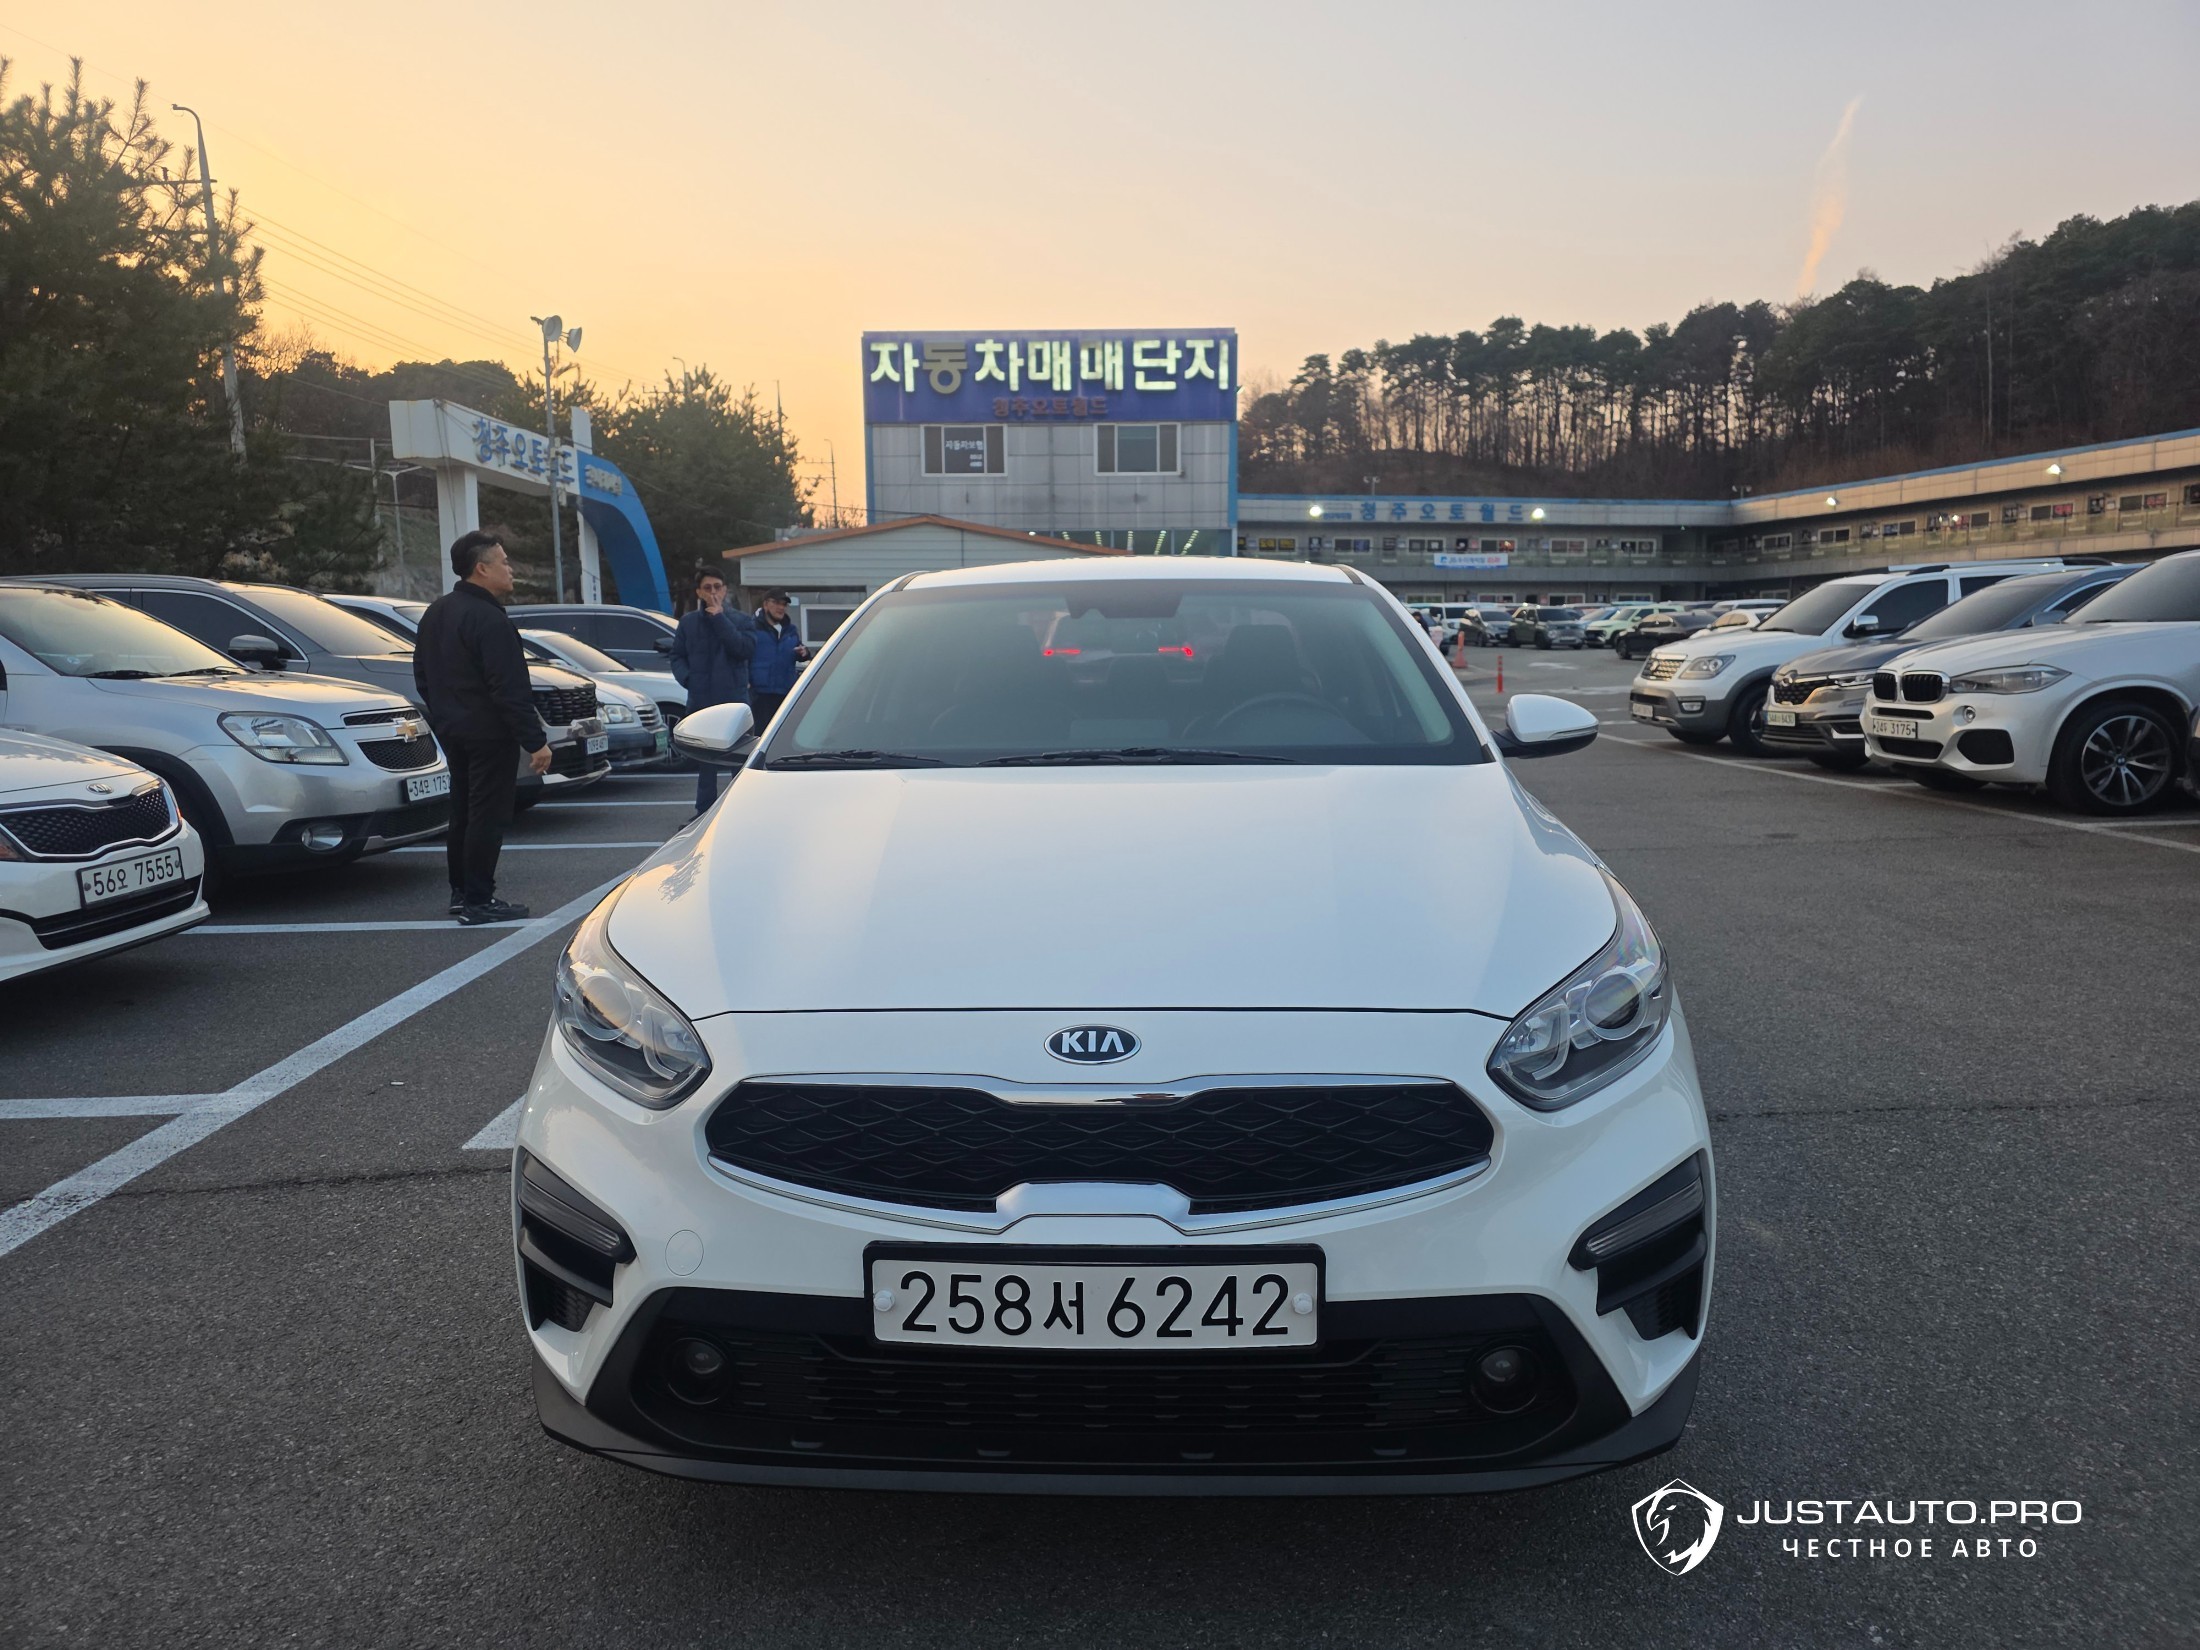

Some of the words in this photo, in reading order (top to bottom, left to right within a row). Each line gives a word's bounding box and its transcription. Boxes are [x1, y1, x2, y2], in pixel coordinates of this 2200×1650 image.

[870, 338, 1230, 395] 자동차매매단지
[1361, 502, 1524, 522] 청주오토월드
[1891, 723, 1912, 736] 3175
[93, 868, 128, 896] 56오
[134, 855, 174, 885] 7555
[1061, 1030, 1125, 1054] KIA
